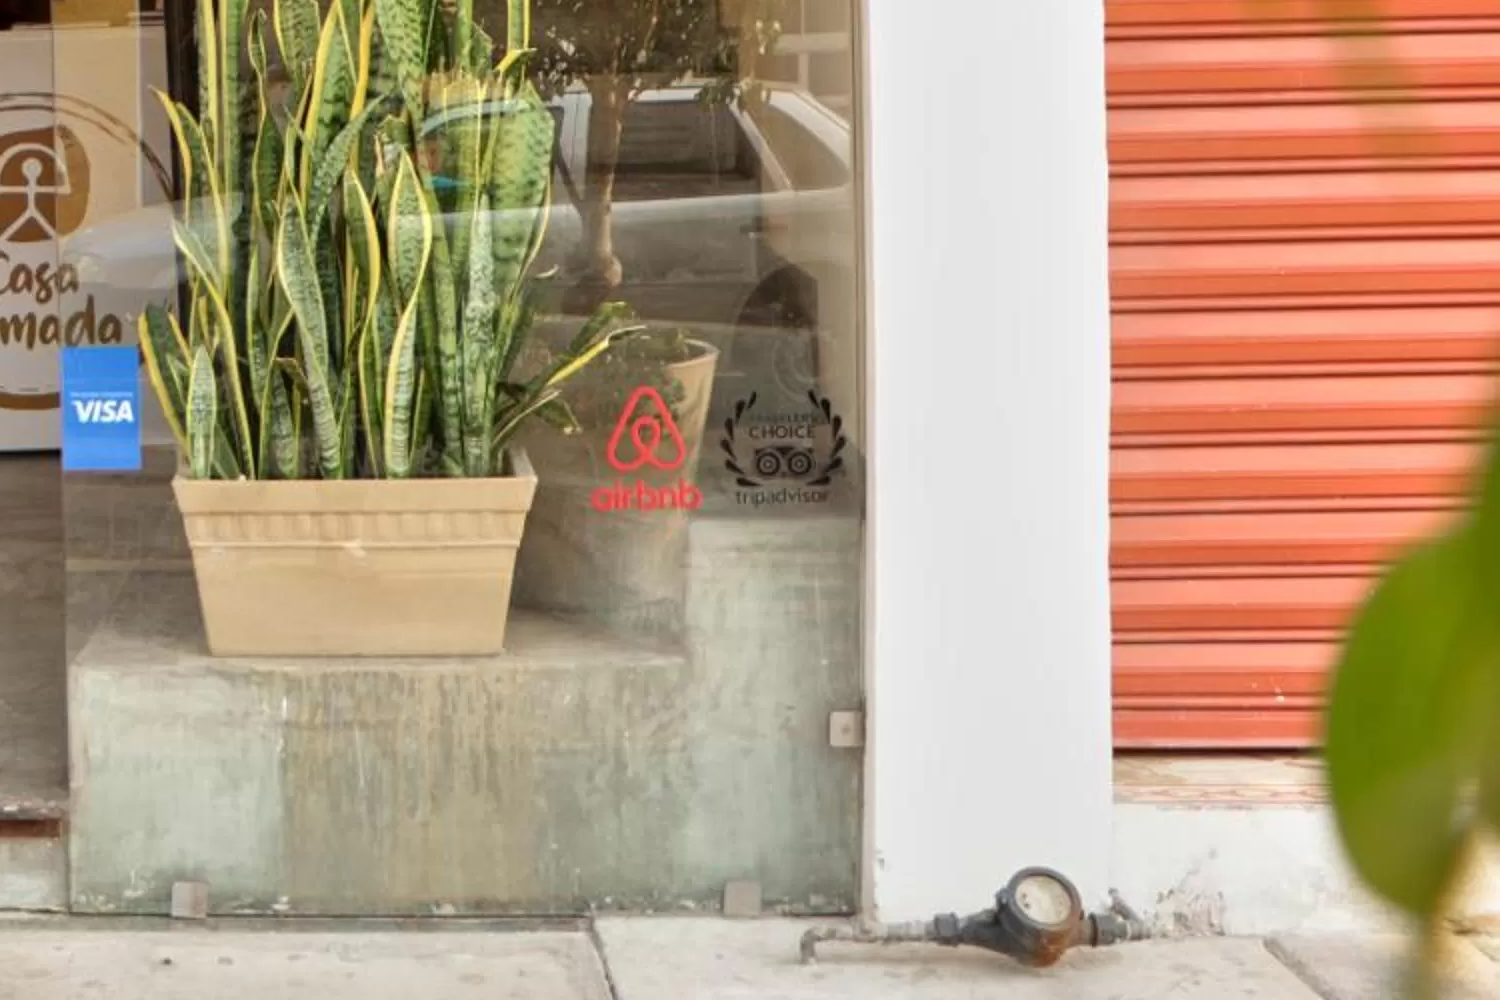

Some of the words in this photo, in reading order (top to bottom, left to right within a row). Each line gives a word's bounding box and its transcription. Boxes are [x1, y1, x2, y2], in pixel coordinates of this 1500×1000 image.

[71, 399, 134, 424] VISA
[749, 424, 817, 440] CHOICE
[590, 481, 703, 512] airbnb
